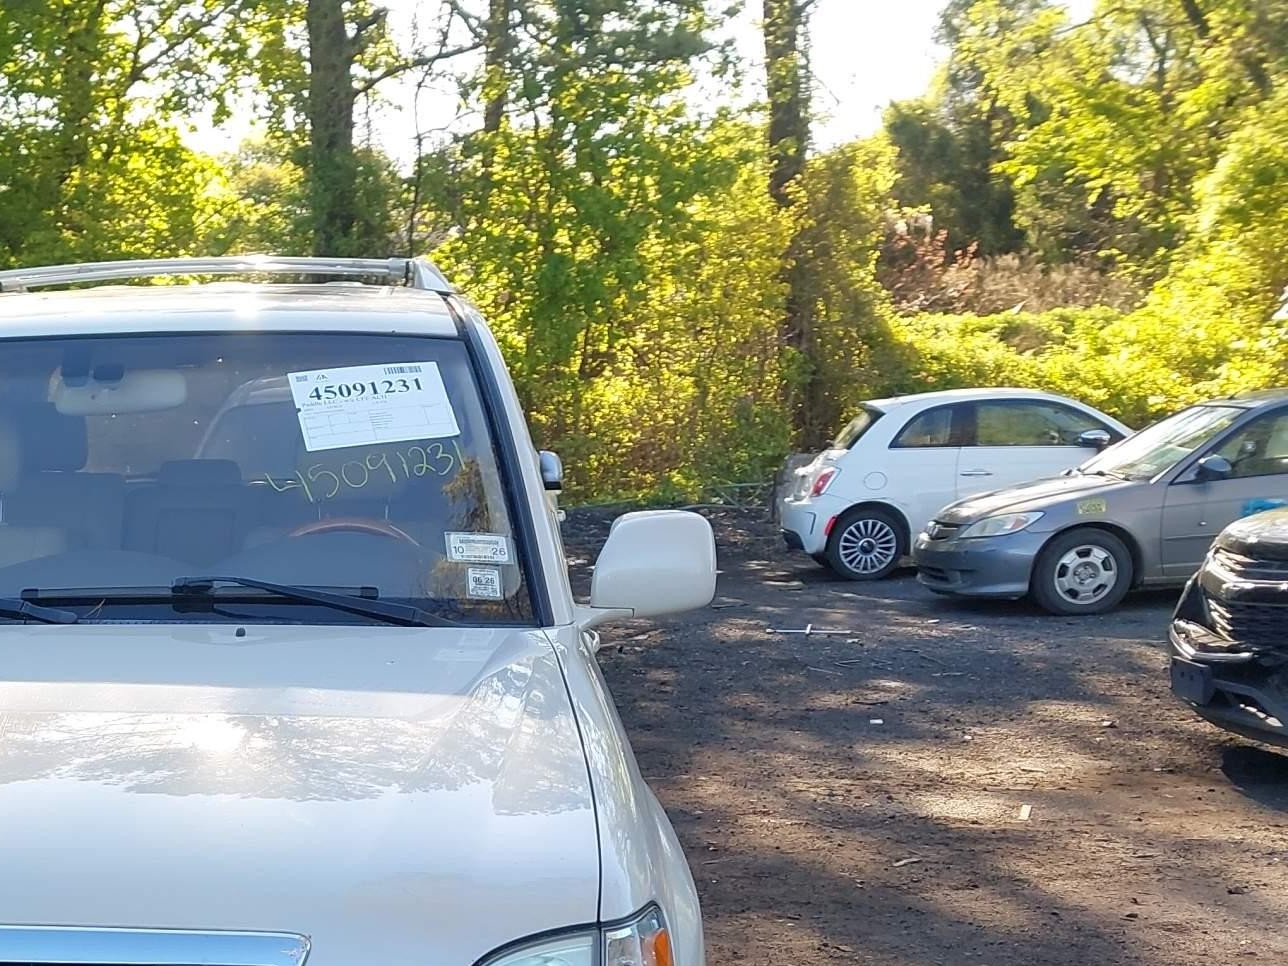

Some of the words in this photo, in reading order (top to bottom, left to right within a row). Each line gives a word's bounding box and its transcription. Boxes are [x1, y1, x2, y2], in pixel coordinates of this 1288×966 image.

[309, 377, 423, 400] 45091231
[265, 440, 466, 502] 45091231
[453, 545, 465, 554] 10
[491, 547, 506, 556] 26
